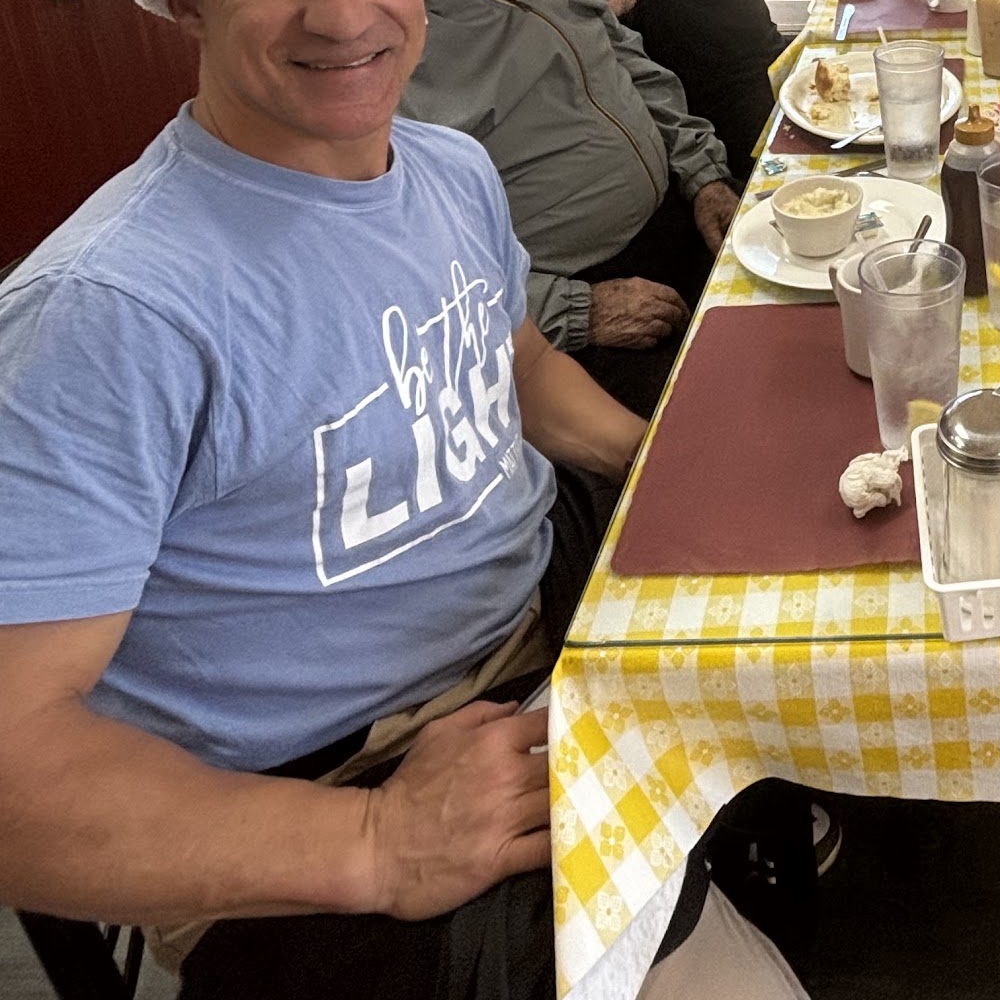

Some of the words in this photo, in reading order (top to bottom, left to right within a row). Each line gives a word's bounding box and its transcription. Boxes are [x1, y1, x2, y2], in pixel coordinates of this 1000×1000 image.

[382, 305, 433, 416] be
[416, 260, 489, 397] the
[341, 334, 515, 550] LIGH
